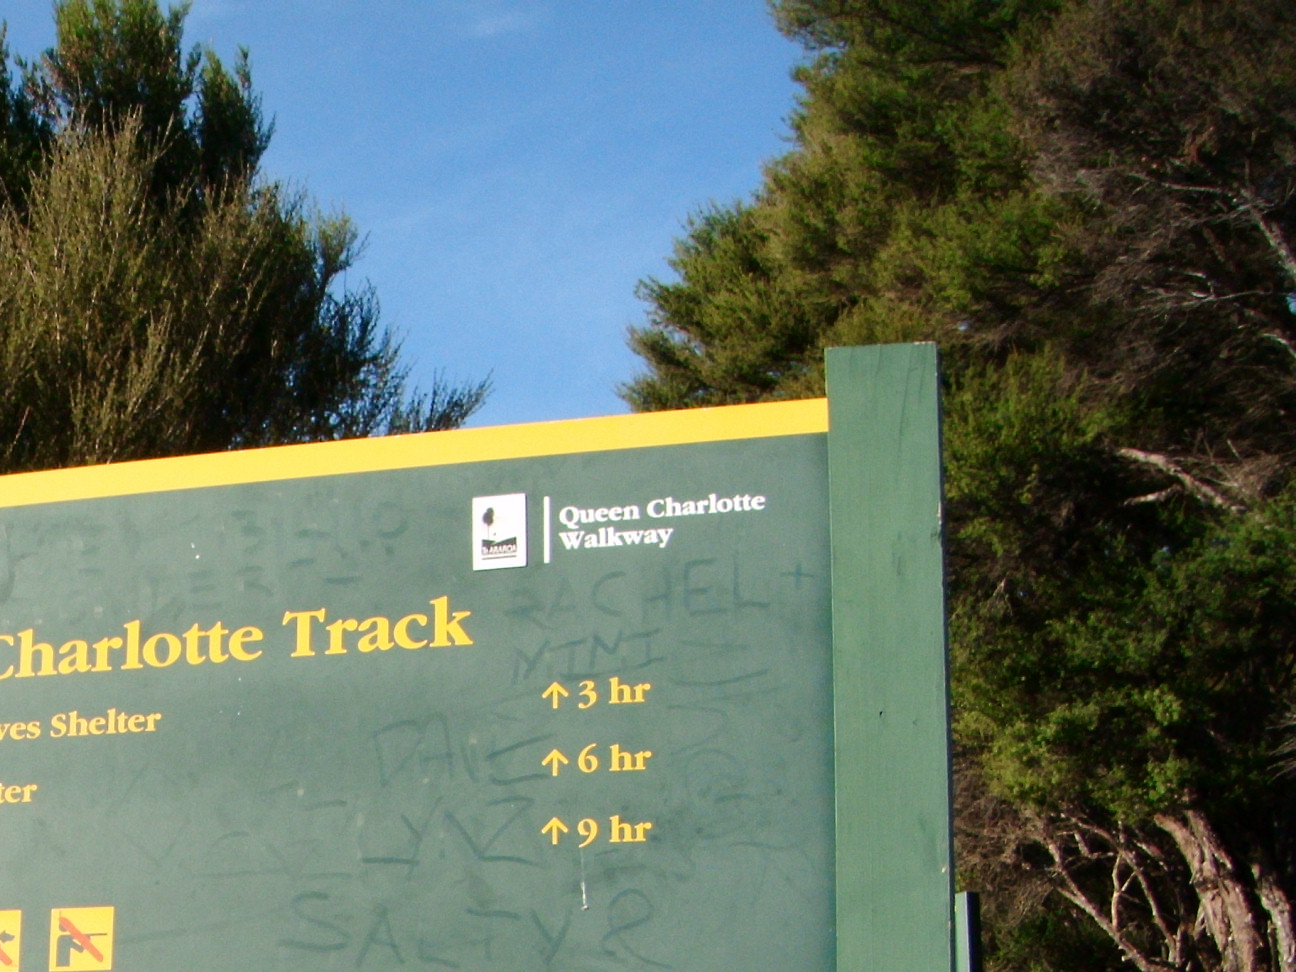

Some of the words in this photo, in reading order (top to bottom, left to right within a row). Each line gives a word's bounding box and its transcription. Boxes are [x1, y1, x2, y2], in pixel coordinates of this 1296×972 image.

[559, 503, 640, 529] Queen
[647, 493, 766, 519] Charlotte
[559, 526, 673, 552] Walkway
[283, 596, 474, 657] Track
[578, 680, 598, 709] 3
[609, 677, 651, 704] hr
[50, 708, 162, 738] Shelter
[578, 743, 599, 774] 6
[609, 744, 652, 771] hr
[578, 816, 598, 848] 9
[609, 815, 652, 843] hr
